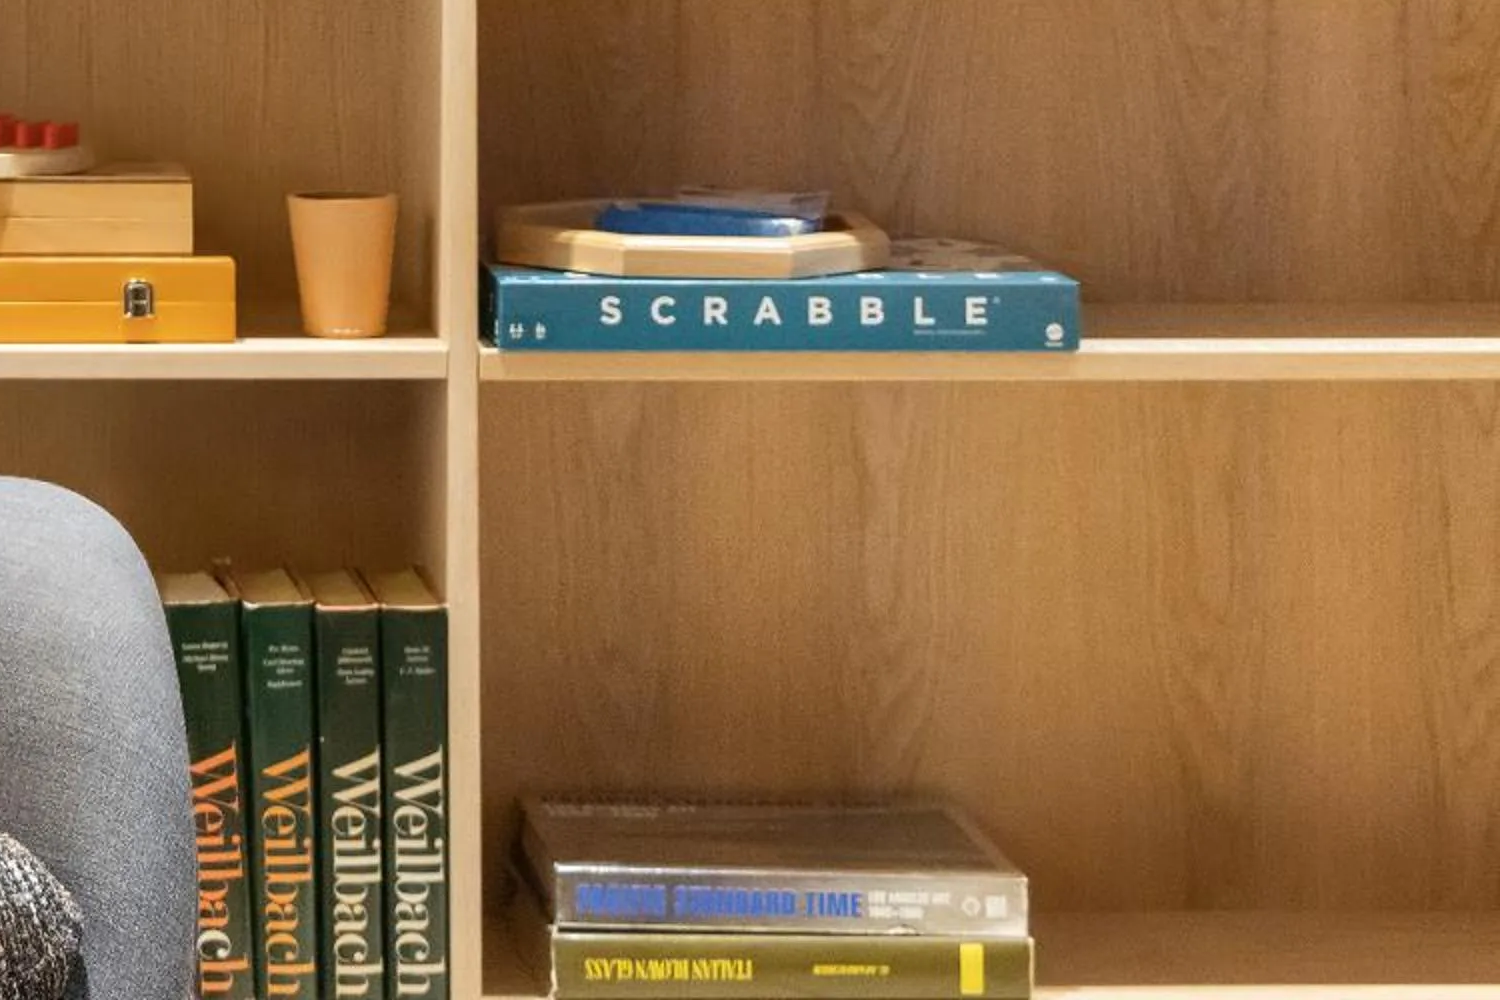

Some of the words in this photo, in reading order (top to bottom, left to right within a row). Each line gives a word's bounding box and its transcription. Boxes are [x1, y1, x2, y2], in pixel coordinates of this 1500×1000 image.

[600, 296, 989, 326] SCRABBLE
[190, 738, 250, 996] Weilbach
[261, 743, 316, 998] Weilbach
[331, 744, 384, 999] Weilbach
[393, 744, 446, 999] Weilbach
[803, 891, 863, 919] TIME
[584, 957, 634, 981] GLASS
[690, 957, 754, 981] ITALIAN
